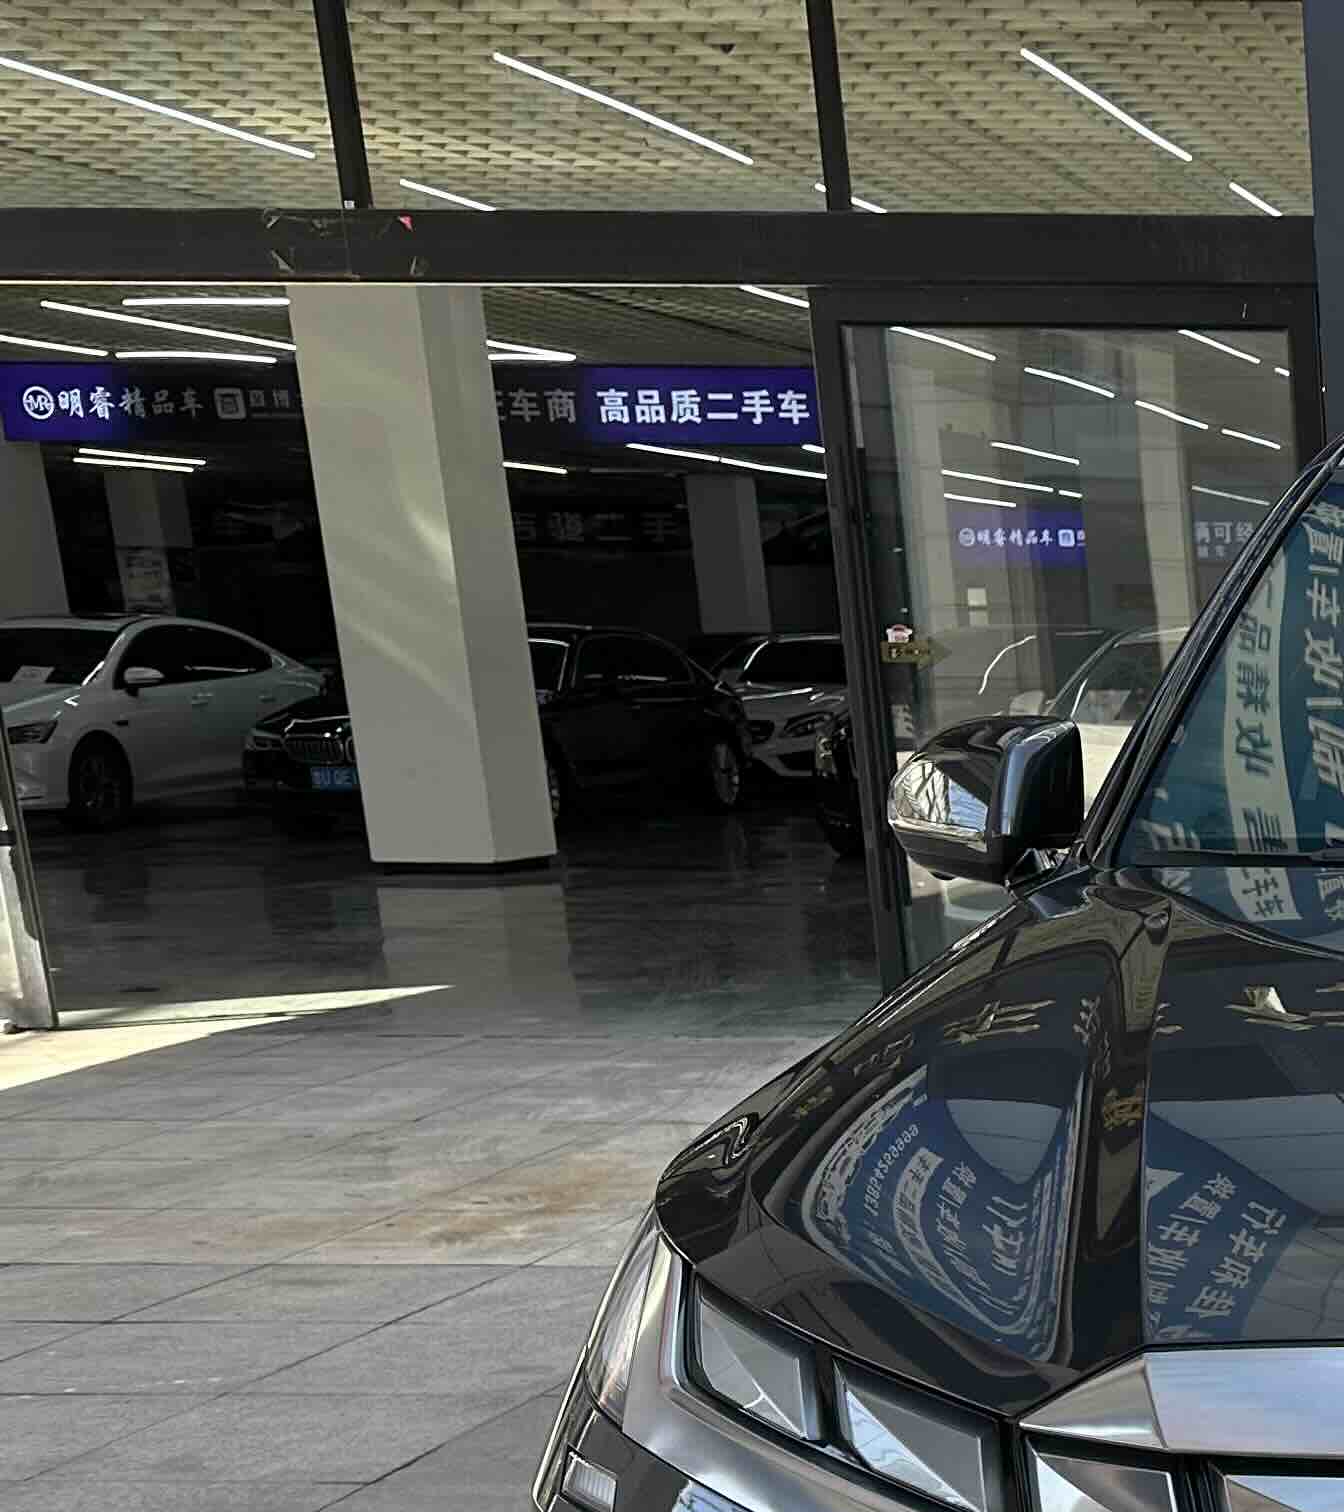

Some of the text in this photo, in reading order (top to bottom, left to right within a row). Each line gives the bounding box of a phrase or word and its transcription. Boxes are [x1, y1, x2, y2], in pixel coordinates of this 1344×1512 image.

[596, 388, 811, 426] 高品质二手车
